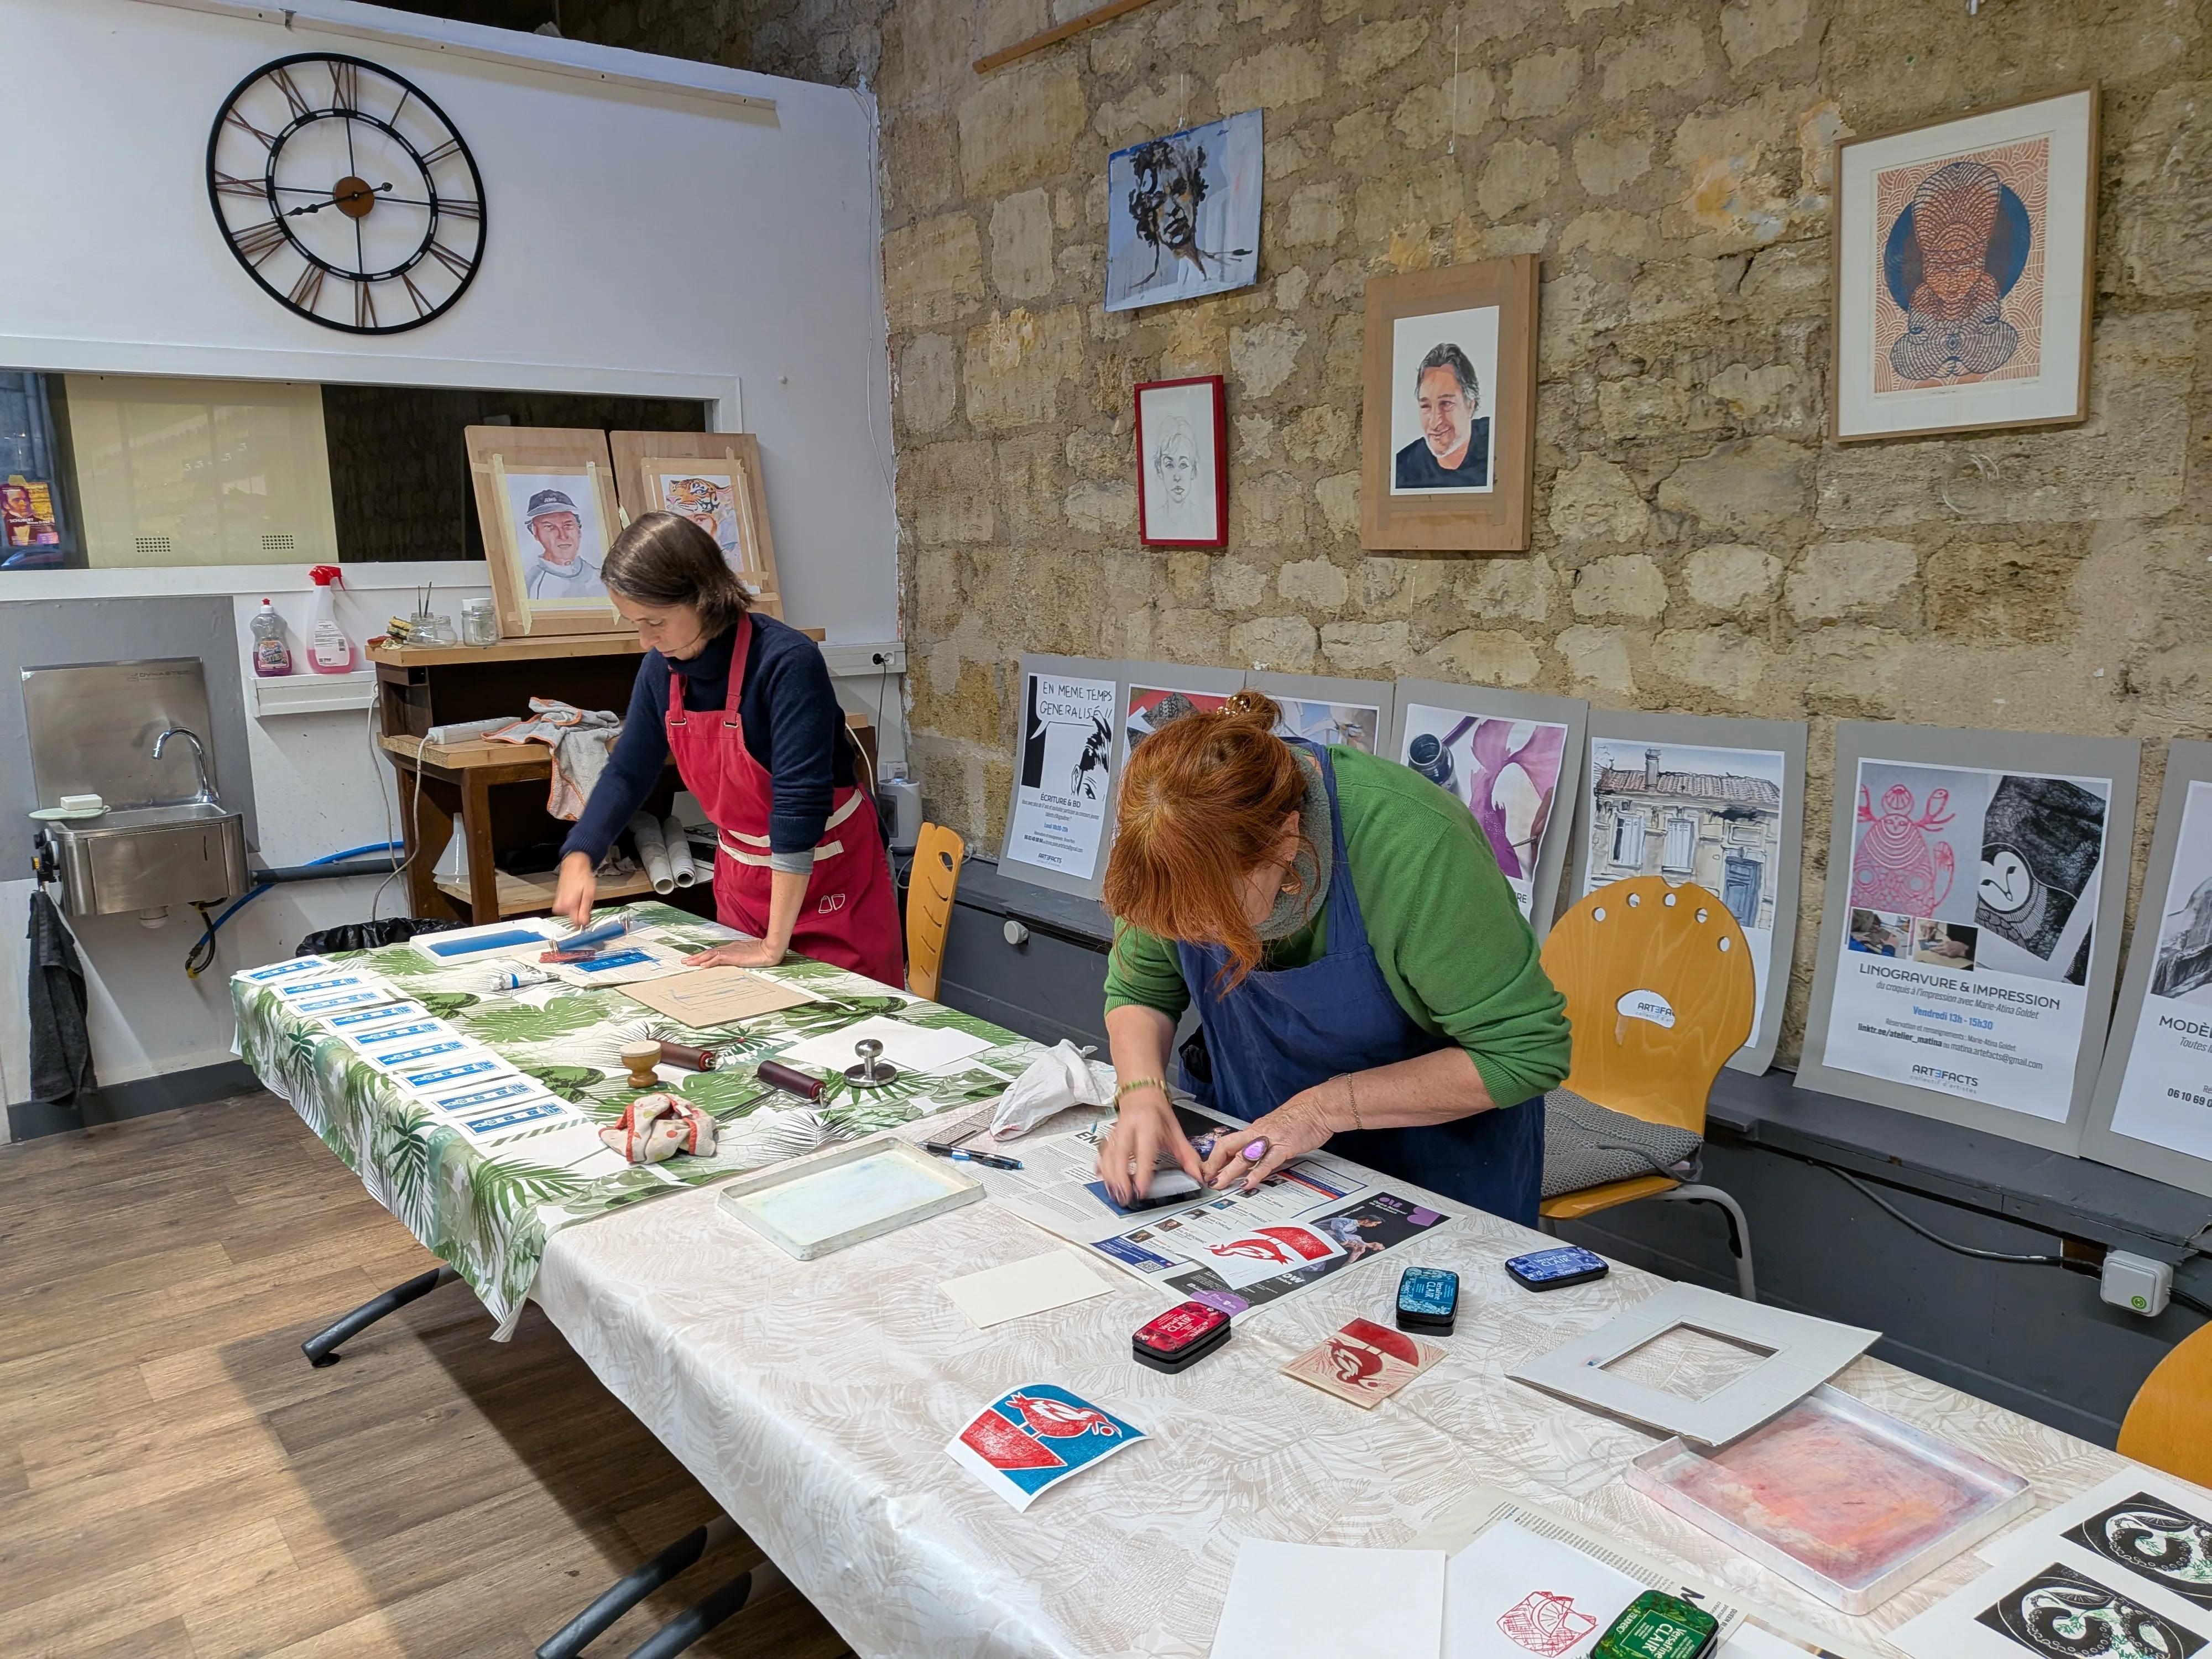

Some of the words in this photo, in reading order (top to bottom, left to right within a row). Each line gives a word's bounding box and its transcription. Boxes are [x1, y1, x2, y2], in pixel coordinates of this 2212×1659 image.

[1043, 681, 1054, 694] EN
[1058, 685, 1084, 698] MEME
[1087, 689, 1112, 702] TEMPS
[1041, 792, 1067, 805] ÉCRITURE
[1859, 963, 1958, 990] LINOGRAVURE
[1960, 982, 1970, 993] &
[1973, 984, 2060, 1010] IMPRESSION
[1876, 980, 1886, 989] du
[1886, 983, 1910, 994] croquis
[1911, 987, 1916, 995] à
[1916, 988, 1957, 1003] l'impression
[1958, 997, 1973, 1007] avec
[1974, 999, 2015, 1015] Marie-Atina
[2016, 1006, 2040, 1020] Goldet
[1637, 1002, 1675, 1016] ARTEFA
[1913, 1005, 1948, 1021] Vendredi
[1949, 1013, 1963, 1024] 13h
[1969, 1017, 1994, 1030] 15h30
[1858, 1022, 1942, 1047] linktr.ee/atelier_matina
[1950, 1043, 2043, 1070] matina.artefacts@gmail.com
[1968, 1034, 1998, 1047] Marie-Atina
[1999, 1041, 2016, 1051] Goldet
[2179, 1036, 2208, 1052] Toutes
[2167, 1088, 2180, 1099] 06
[2181, 1092, 2192, 1102] 10
[2193, 1095, 2206, 1106] 69
[1387, 1205, 1407, 1215] National
[1215, 1220, 1232, 1231] CHICHE
[1533, 1254, 1568, 1263] VersaFine
[1541, 1258, 1572, 1267] CLAIR
[1275, 1276, 1292, 1285] ctobre
[1425, 1281, 1436, 1298] CLAIR
[1434, 1282, 1444, 1300] VersaFine
[1159, 1313, 1189, 1330] VersaFine
[1167, 1317, 1194, 1332] CLAIR
[1723, 1608, 1738, 1623] QUEEN
[1641, 1623, 1673, 1654] CLAIR
[1654, 1627, 1687, 1659] VersaFine
